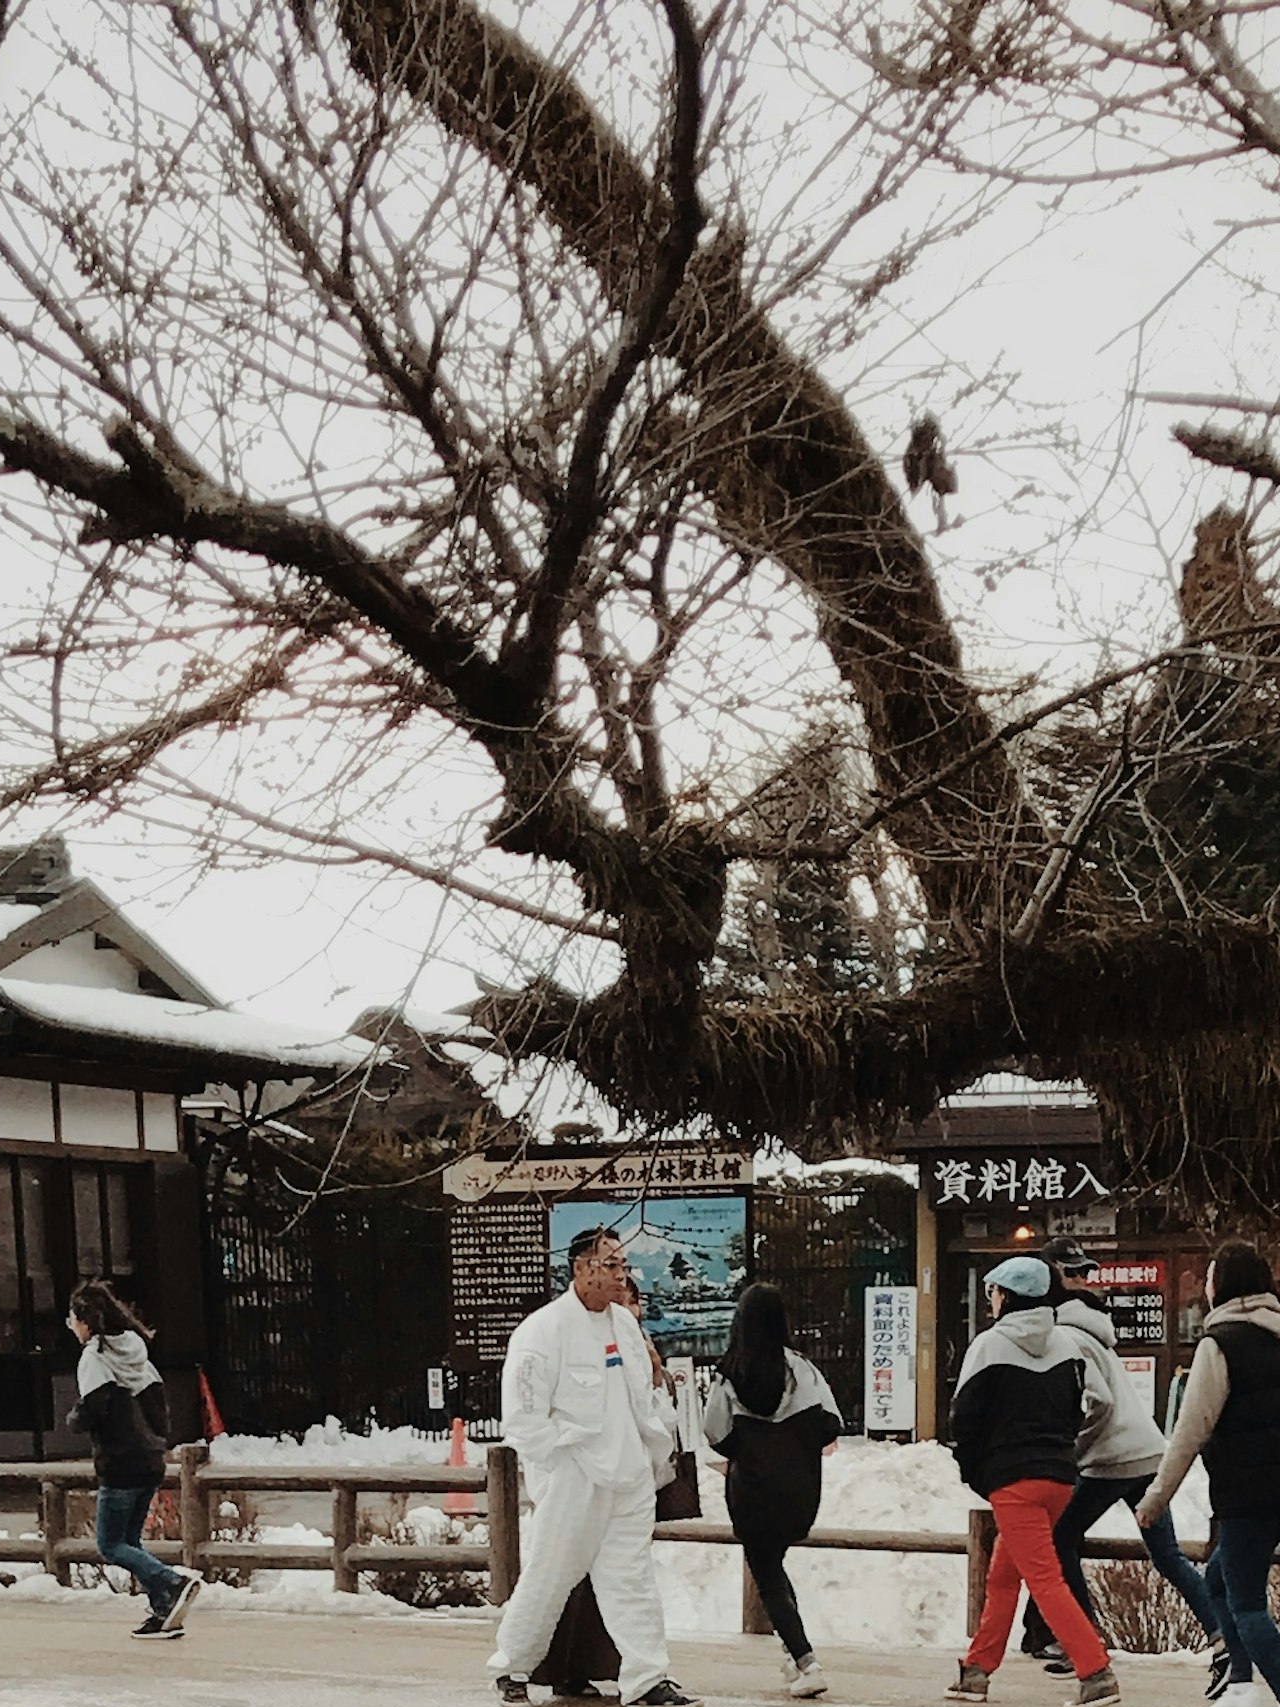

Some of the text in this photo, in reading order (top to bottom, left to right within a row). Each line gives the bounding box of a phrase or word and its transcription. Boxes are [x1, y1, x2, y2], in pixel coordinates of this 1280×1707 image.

[1136, 1295, 1163, 1308] ¥300
[1136, 1310, 1163, 1323] ¥150
[897, 1292, 911, 1356] これより先
[1136, 1326, 1163, 1339] ¥100
